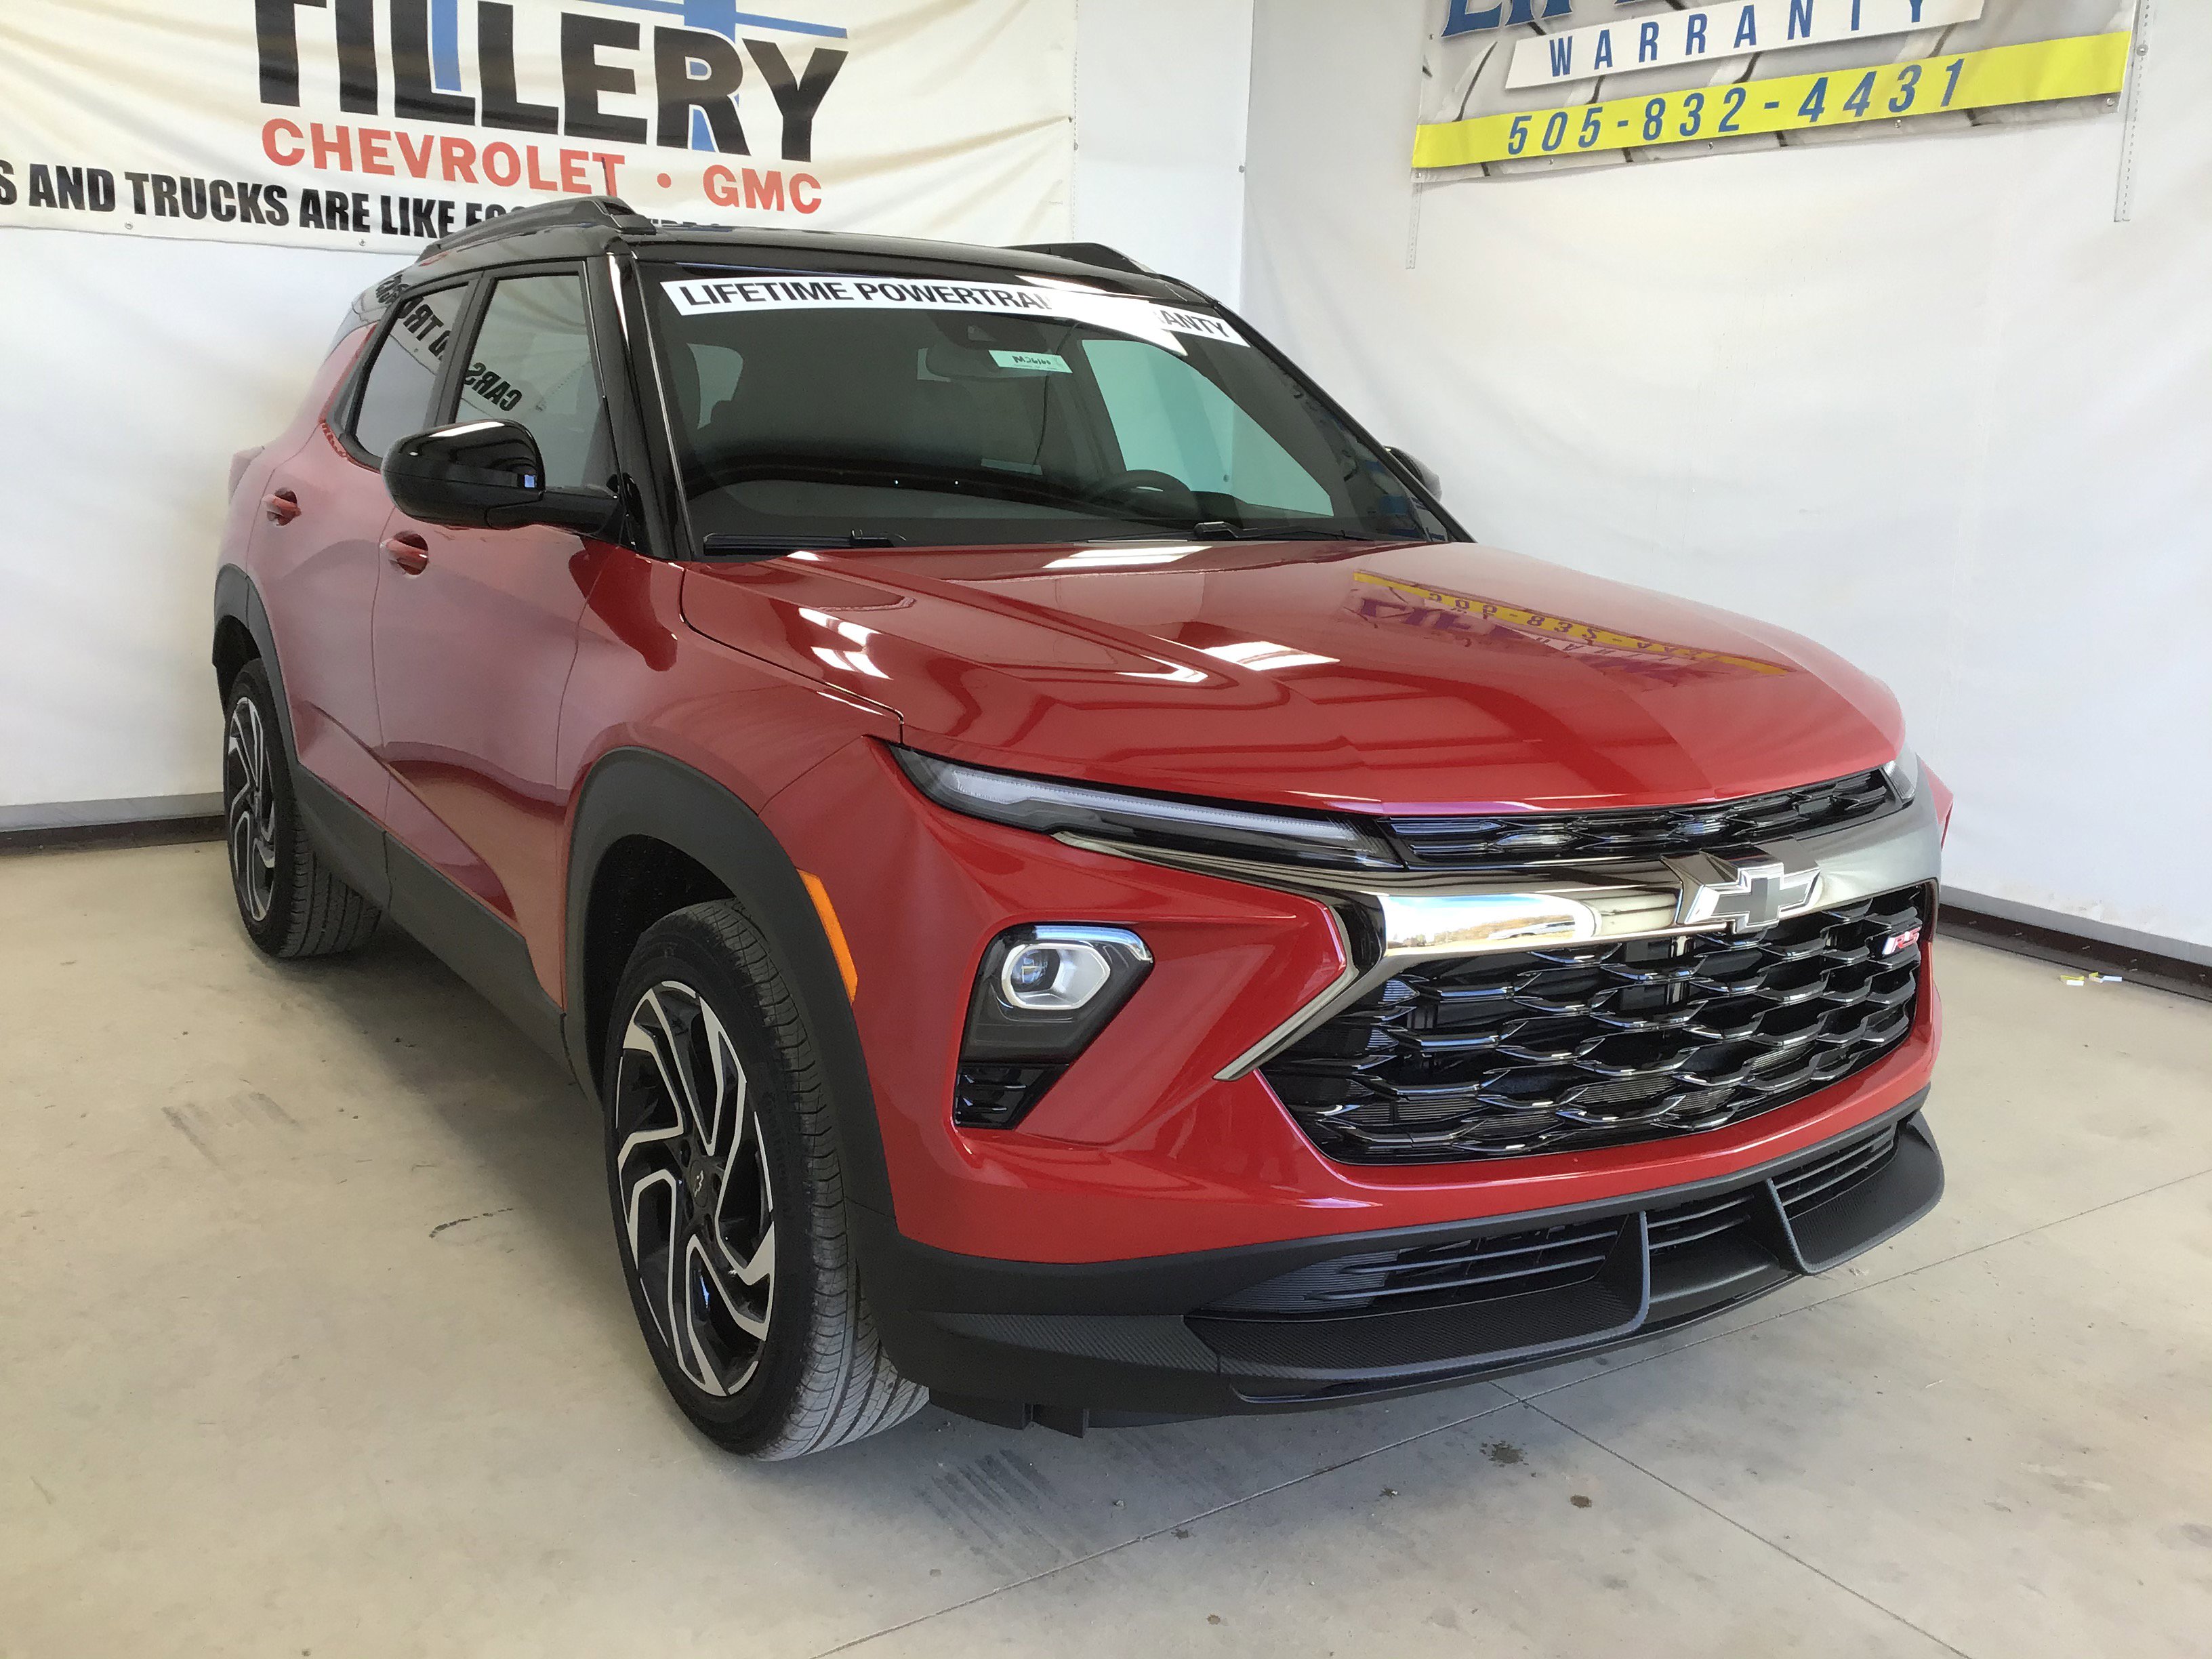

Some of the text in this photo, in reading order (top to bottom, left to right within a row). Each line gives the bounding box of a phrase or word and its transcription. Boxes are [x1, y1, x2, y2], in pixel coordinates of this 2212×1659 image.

[255, 0, 848, 163] TILLERY
[1507, 58, 1965, 156] 505-832-4431
[29, 163, 115, 212] AND
[125, 171, 290, 226] TRUCKS
[299, 189, 371, 233] ARE
[380, 195, 455, 239] LIKE
[261, 118, 822, 214] CHEVROLET GMC
[679, 281, 854, 306] LIFETIME
[861, 282, 1052, 310] POWERTRAI
